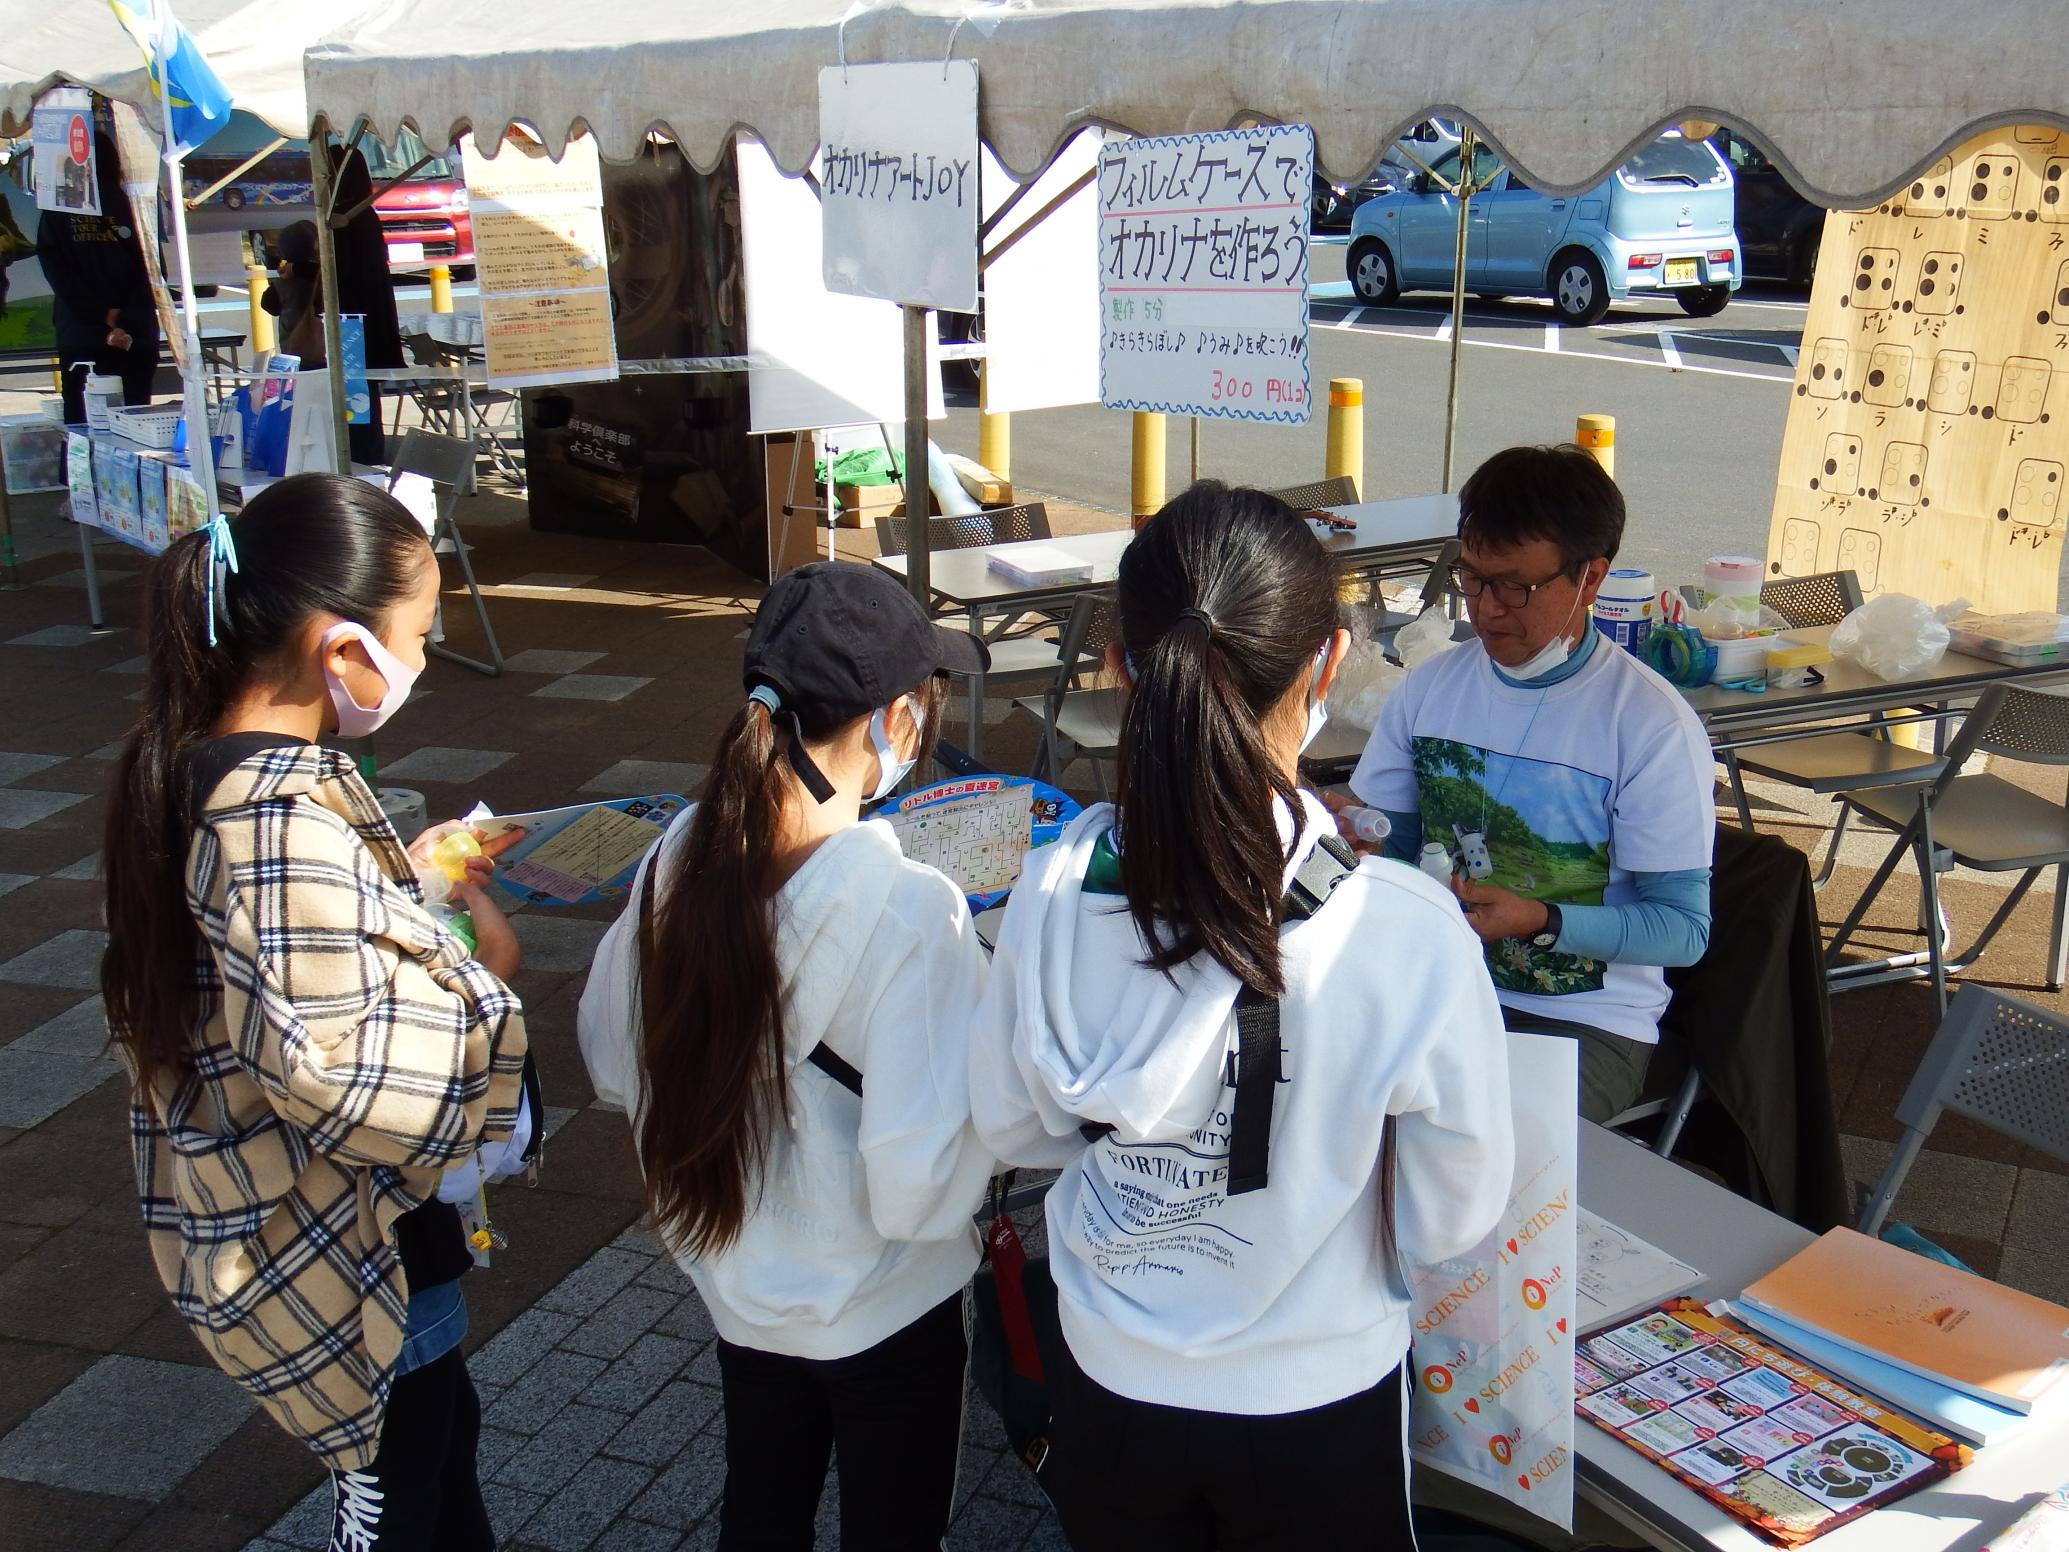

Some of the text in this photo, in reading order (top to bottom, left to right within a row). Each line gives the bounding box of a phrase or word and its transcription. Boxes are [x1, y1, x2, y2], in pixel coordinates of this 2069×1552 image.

[1104, 141, 1304, 211] フィルムケースで
[1109, 216, 1306, 286] オカリナを作ろう
[1211, 370, 1253, 400] 300
[569, 440, 616, 464] ようこそ
[1158, 1198, 1225, 1220] HONESTY
[1416, 1267, 1490, 1336] SCIENCE
[1479, 1344, 1541, 1404] SCIENCE
